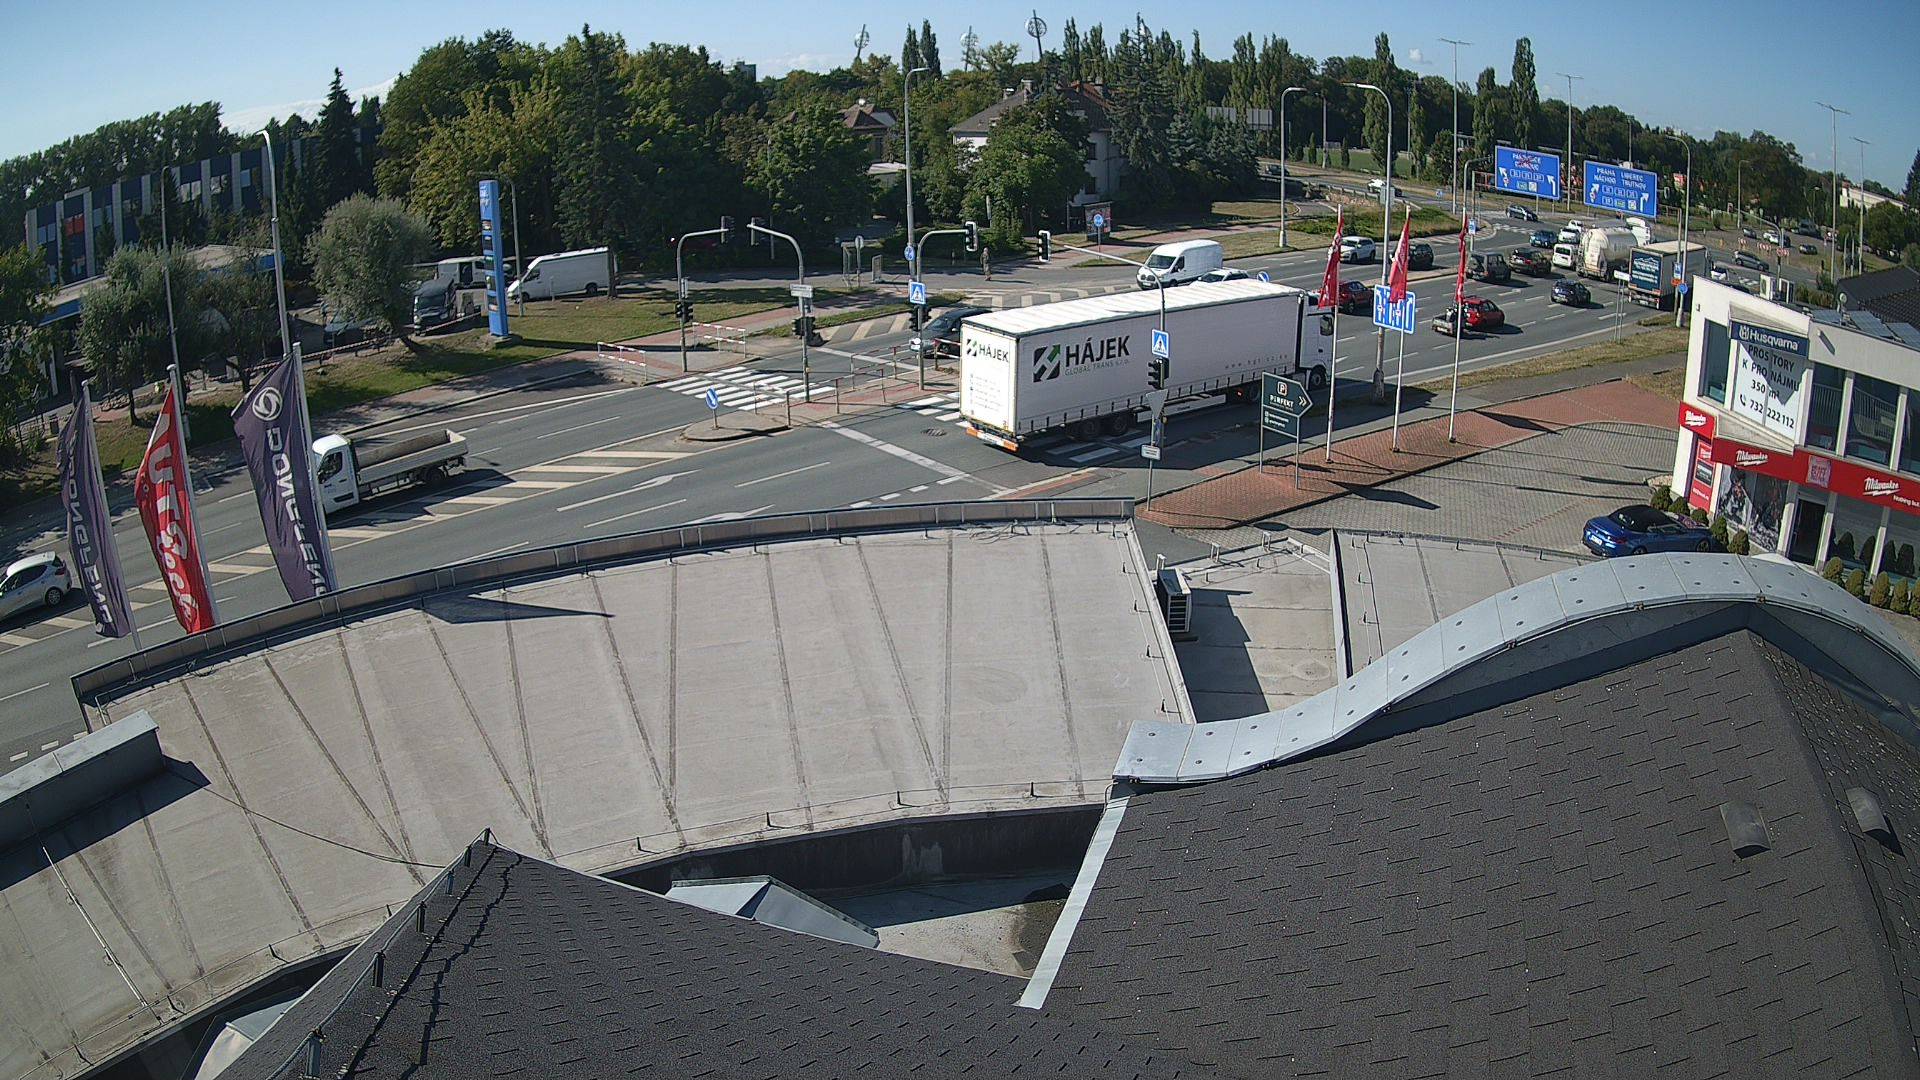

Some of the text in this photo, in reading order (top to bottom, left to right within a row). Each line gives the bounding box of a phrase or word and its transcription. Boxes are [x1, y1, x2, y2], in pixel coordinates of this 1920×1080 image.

[1750, 329, 1798, 351] Husqvarna
[979, 344, 1009, 362] HÁJEK
[1065, 335, 1130, 367] HÁJEK
[1064, 366, 1091, 376] GLOBAL
[1093, 361, 1114, 371] TRANS
[1742, 358, 1748, 370] K
[1751, 379, 1766, 393] 350
[1750, 399, 1795, 429] 732 222 112
[1735, 450, 1769, 462] Milwaukee
[1864, 476, 1899, 490] Milwaukee
